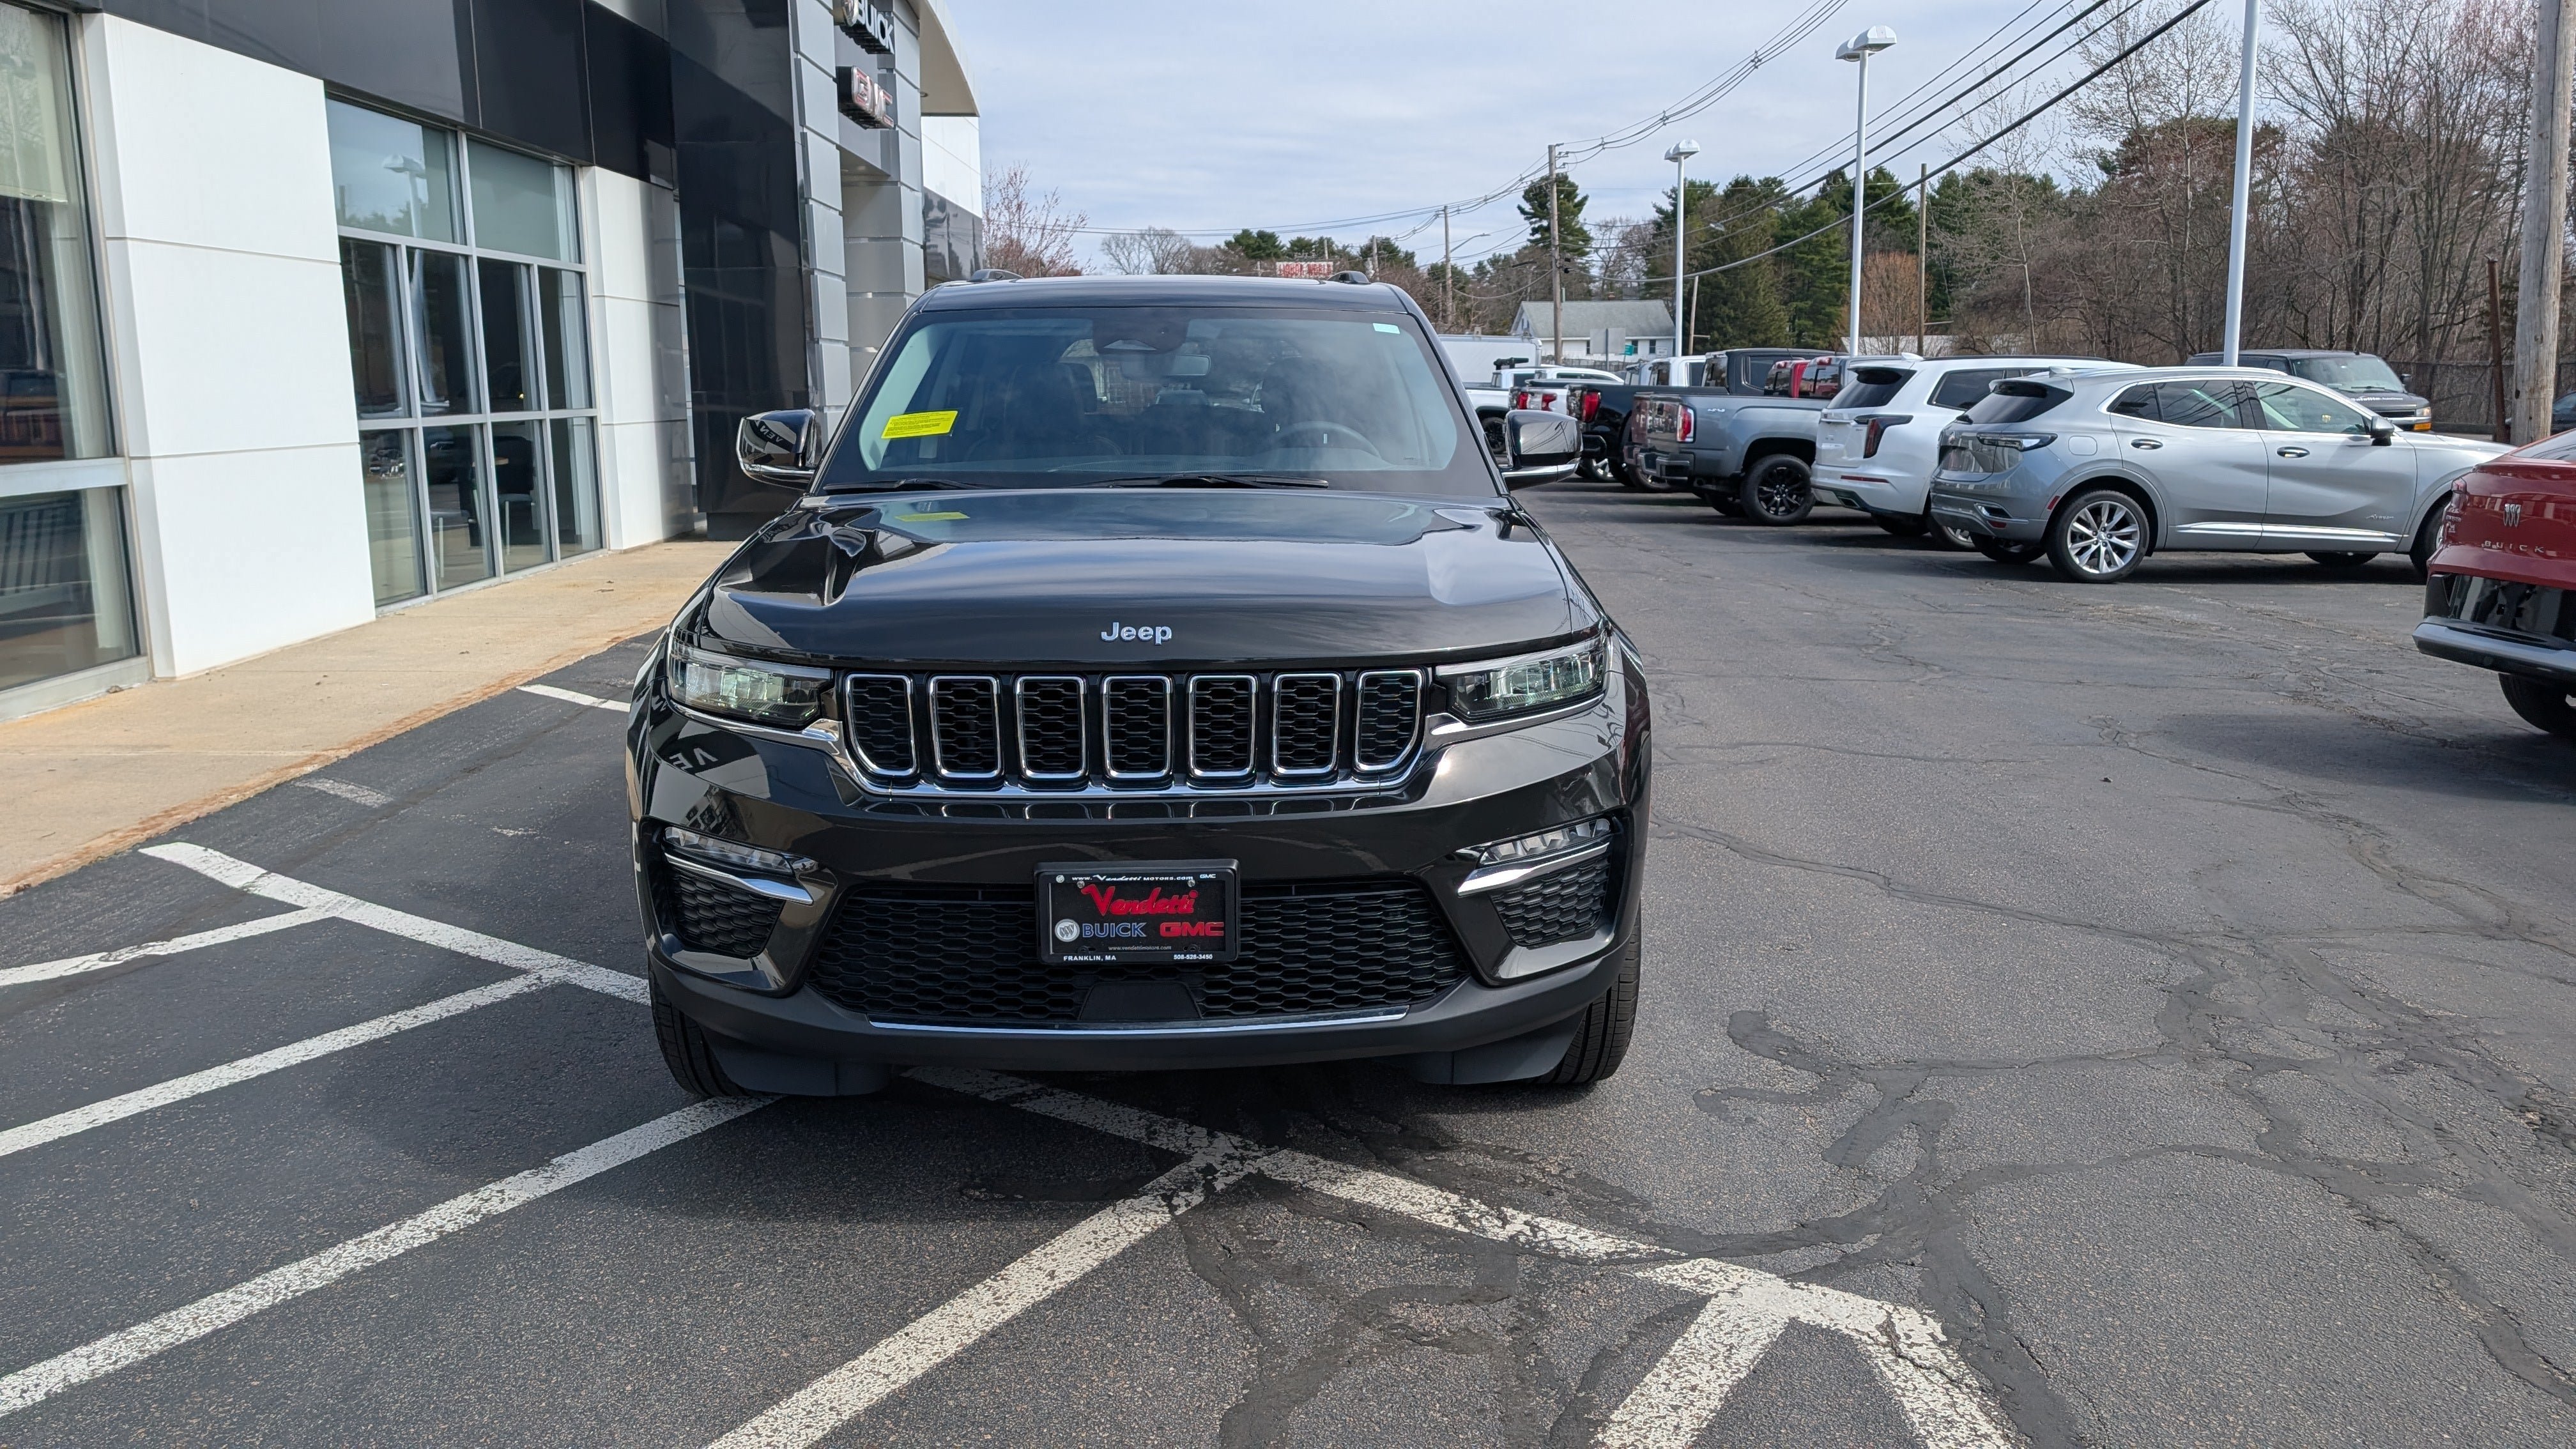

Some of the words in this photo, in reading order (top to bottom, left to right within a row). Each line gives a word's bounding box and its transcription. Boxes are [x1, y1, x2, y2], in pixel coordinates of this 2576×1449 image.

[2485, 540, 2545, 553] BUICK
[1101, 622, 1172, 645] Jeep
[1081, 883, 1199, 916] Vendetti
[1082, 922, 1147, 938] BUICK
[1160, 921, 1224, 937] GMC
